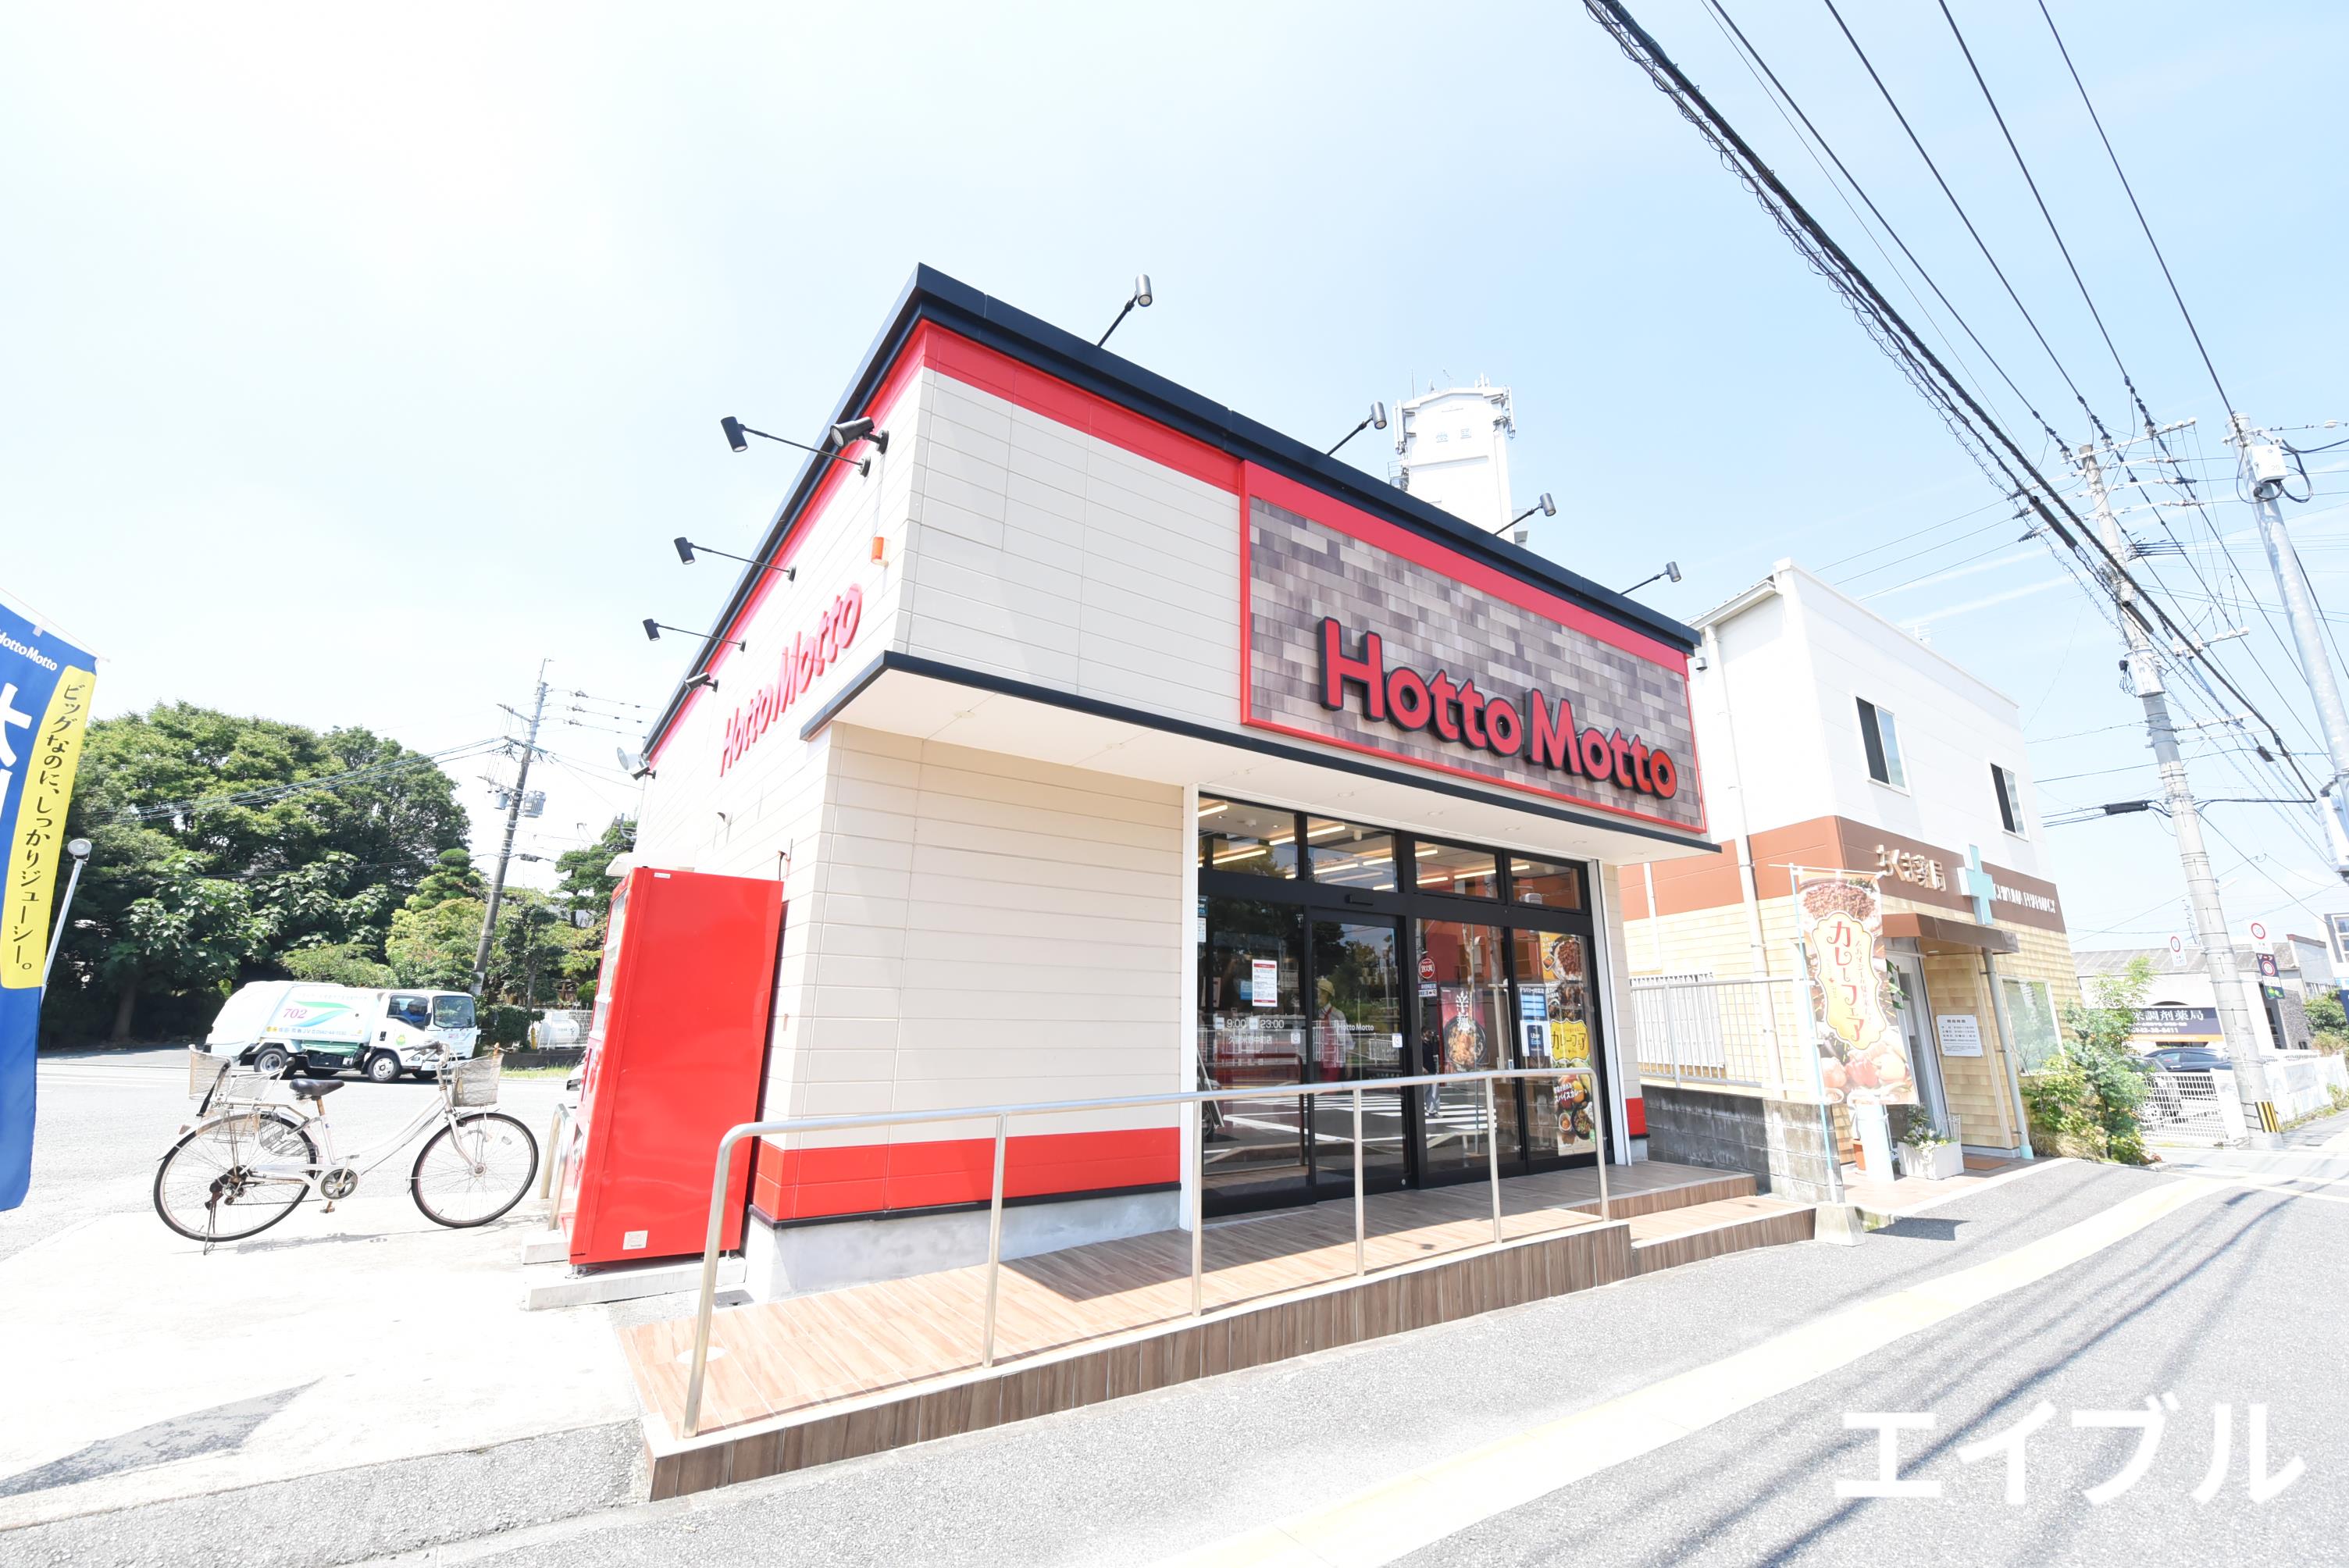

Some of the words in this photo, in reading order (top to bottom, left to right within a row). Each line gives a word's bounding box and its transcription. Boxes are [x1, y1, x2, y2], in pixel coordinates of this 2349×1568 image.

[719, 683, 774, 778] Hotto
[771, 583, 863, 723] Motto
[1317, 615, 1522, 758] Hotto
[1525, 687, 1677, 800] Motto
[12, 683, 86, 971] ビッグなのに、しっかりジューシー。
[283, 1008, 308, 1019] 702
[1227, 1018, 1246, 1028] 9:00
[1260, 1019, 1285, 1028] 23:00
[1827, 921, 1865, 1042] カレーフェア
